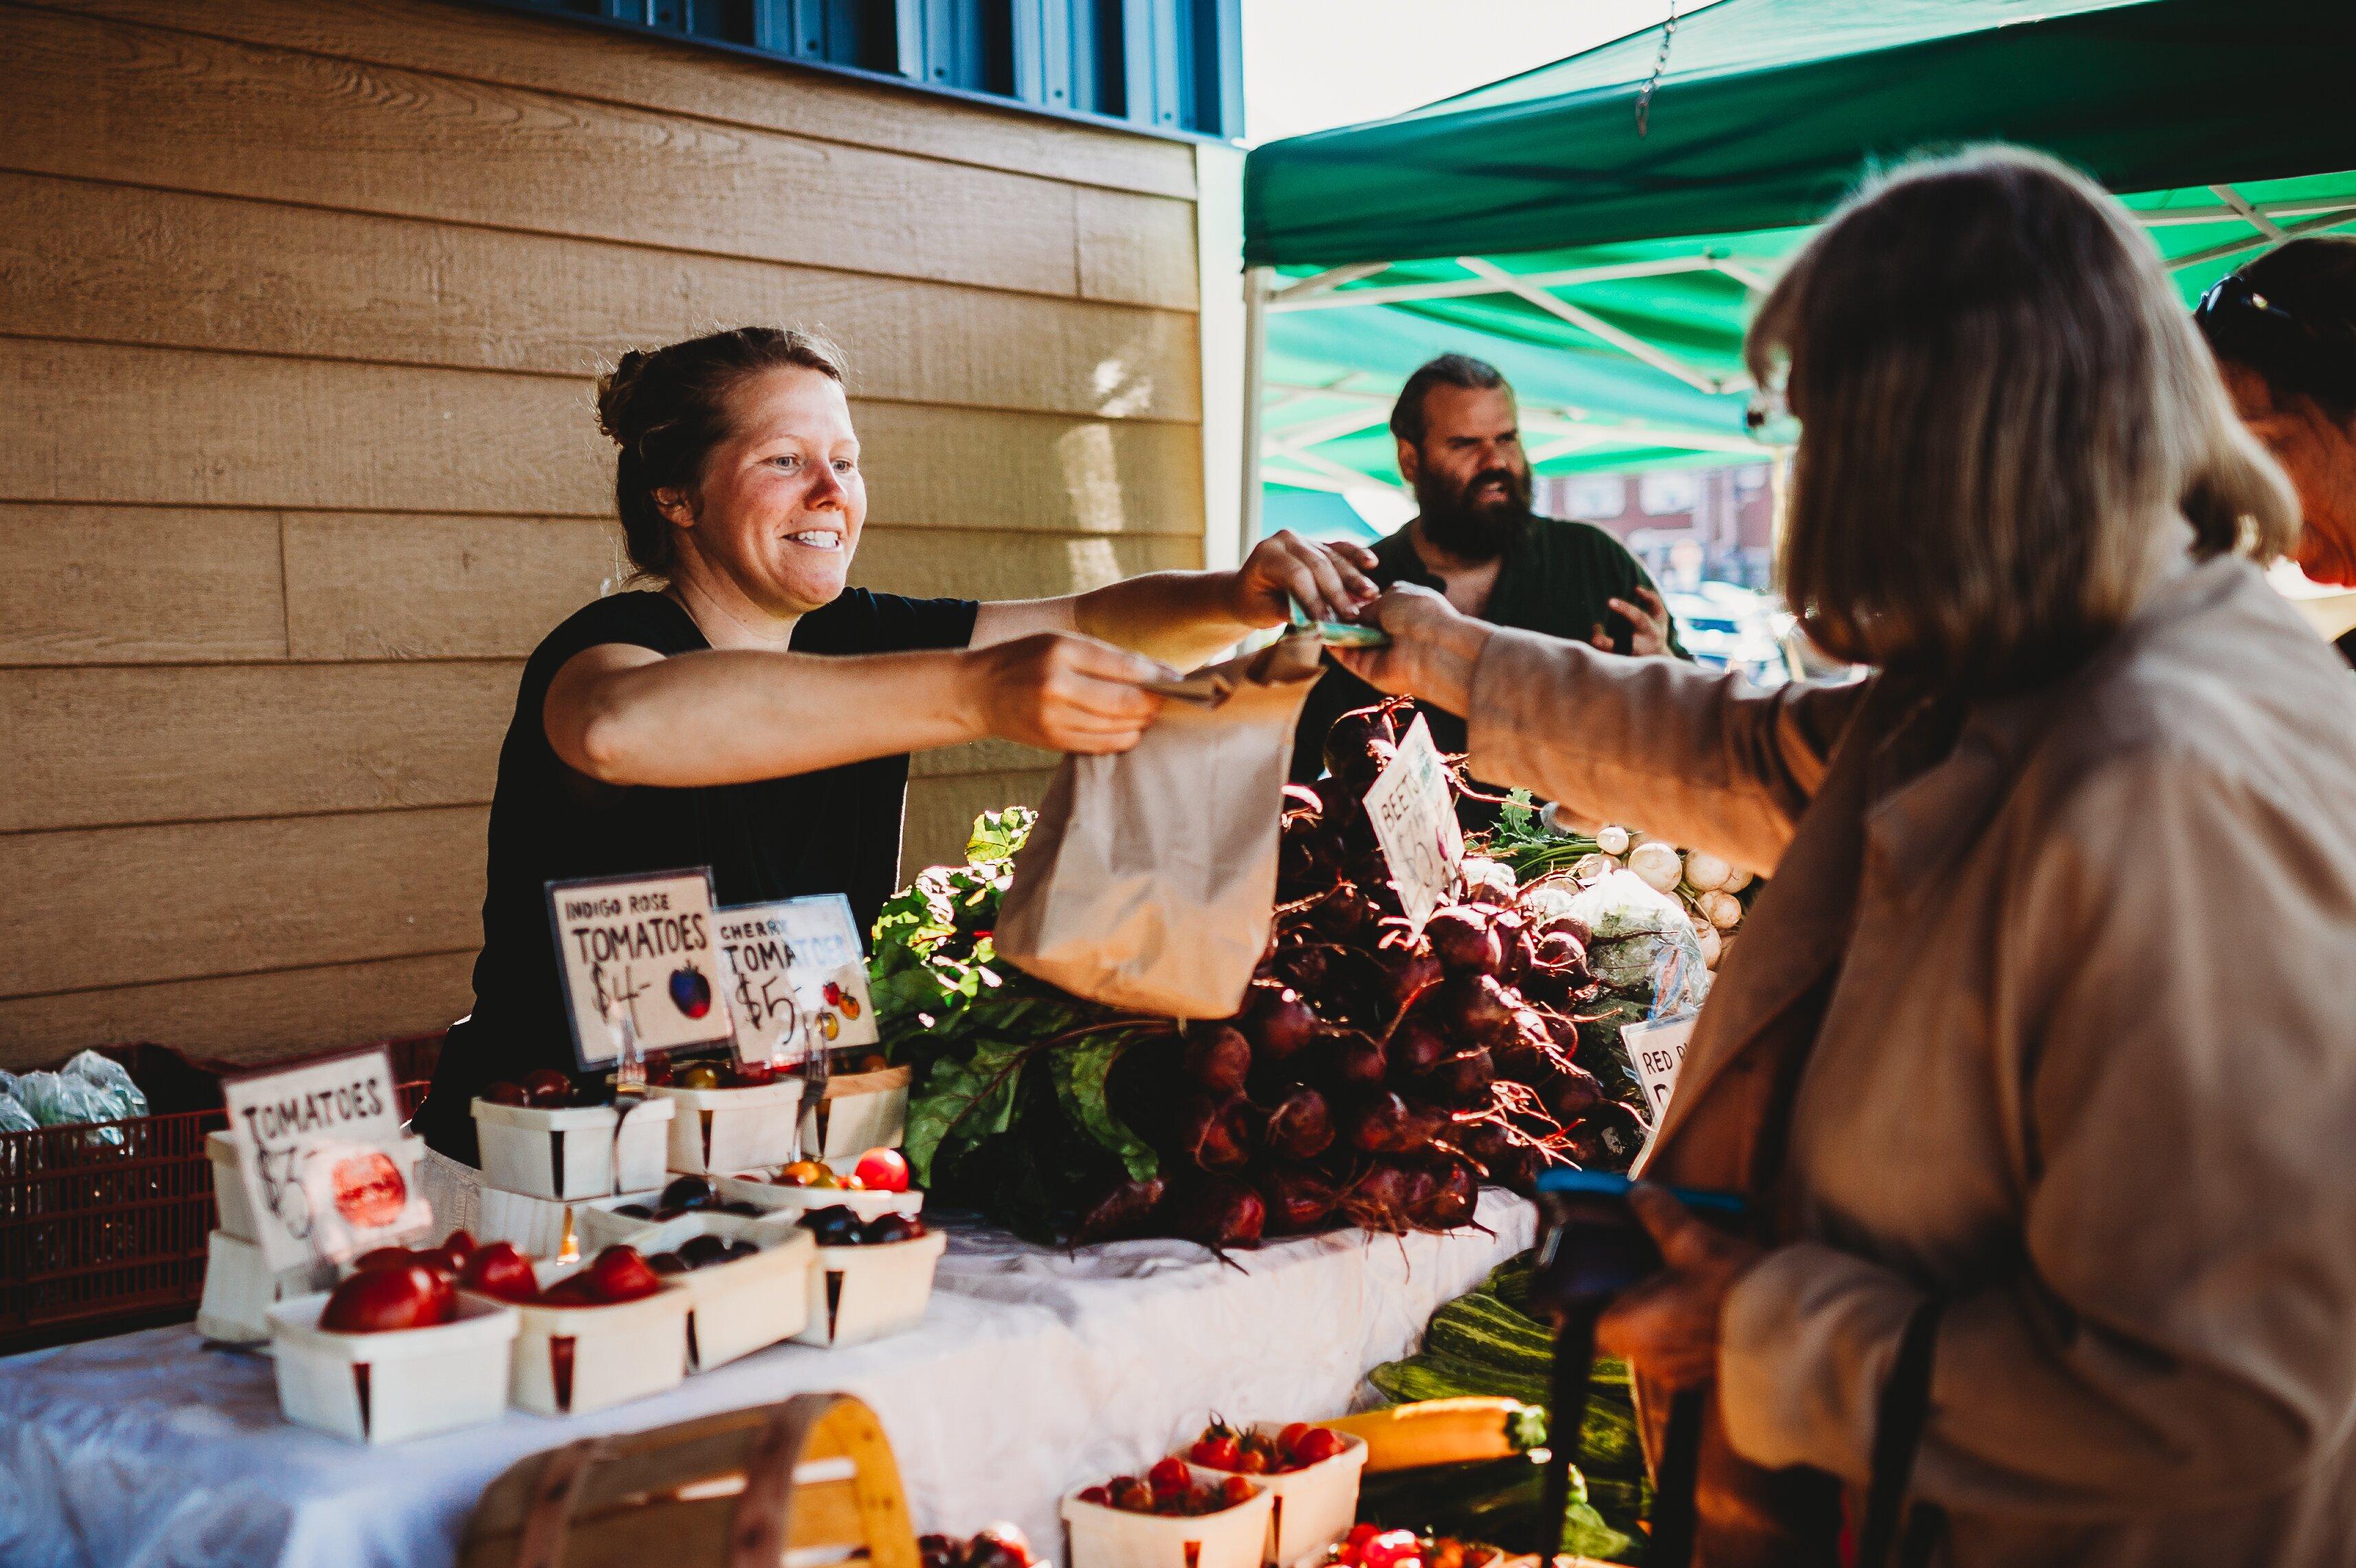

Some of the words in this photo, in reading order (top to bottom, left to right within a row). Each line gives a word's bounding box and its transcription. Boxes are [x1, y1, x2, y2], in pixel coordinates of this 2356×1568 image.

[565, 898, 621, 921] INDIGO
[629, 893, 670, 913] ROSE
[572, 913, 708, 965] TOMATOES
[721, 919, 787, 939] CHERRY
[1642, 1050, 1673, 1075] RED
[242, 1078, 383, 1142] TOMATOES
